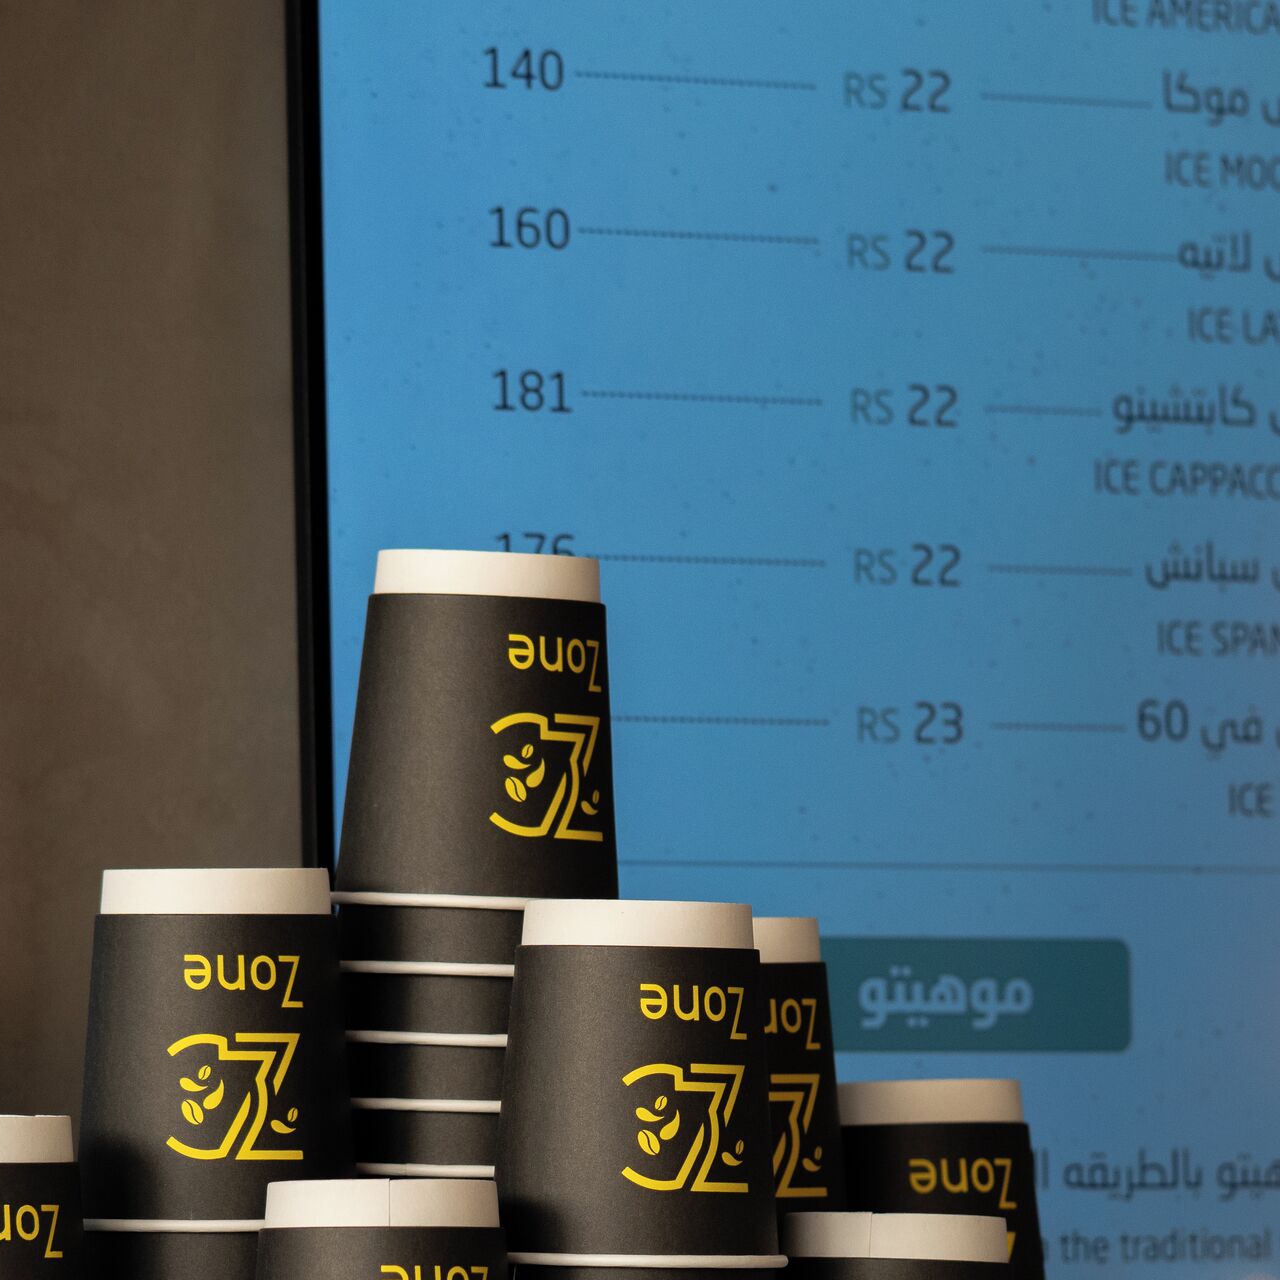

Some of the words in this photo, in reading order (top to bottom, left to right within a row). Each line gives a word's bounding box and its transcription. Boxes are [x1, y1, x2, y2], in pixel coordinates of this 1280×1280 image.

[1092, 0, 1137, 28] ICE
[482, 47, 564, 91] 140
[844, 71, 889, 110] RS
[900, 68, 951, 113] 22
[1163, 72, 1250, 126] موكا
[1165, 151, 1212, 188] ICE
[488, 206, 570, 250] 160
[847, 233, 891, 271] RS
[905, 229, 954, 274] 22
[1188, 307, 1232, 344] ICE
[494, 369, 571, 413] 181
[851, 388, 894, 426] RS
[908, 384, 957, 427] 22
[1095, 459, 1139, 495] ICE
[854, 548, 897, 586] RS
[911, 543, 961, 587] 22
[1158, 620, 1201, 656] ICE
[507, 632, 601, 692] Zone
[857, 706, 900, 744] RS
[915, 701, 963, 744] 23
[1137, 699, 1189, 742] 60
[1229, 783, 1271, 817] ICE
[183, 953, 304, 1009] Zone
[859, 966, 1032, 1029] موهيتو
[639, 982, 747, 1040] Zone
[909, 1158, 1016, 1209] Zone
[1060, 1231, 1109, 1264] the
[1119, 1229, 1271, 1262] traditional
